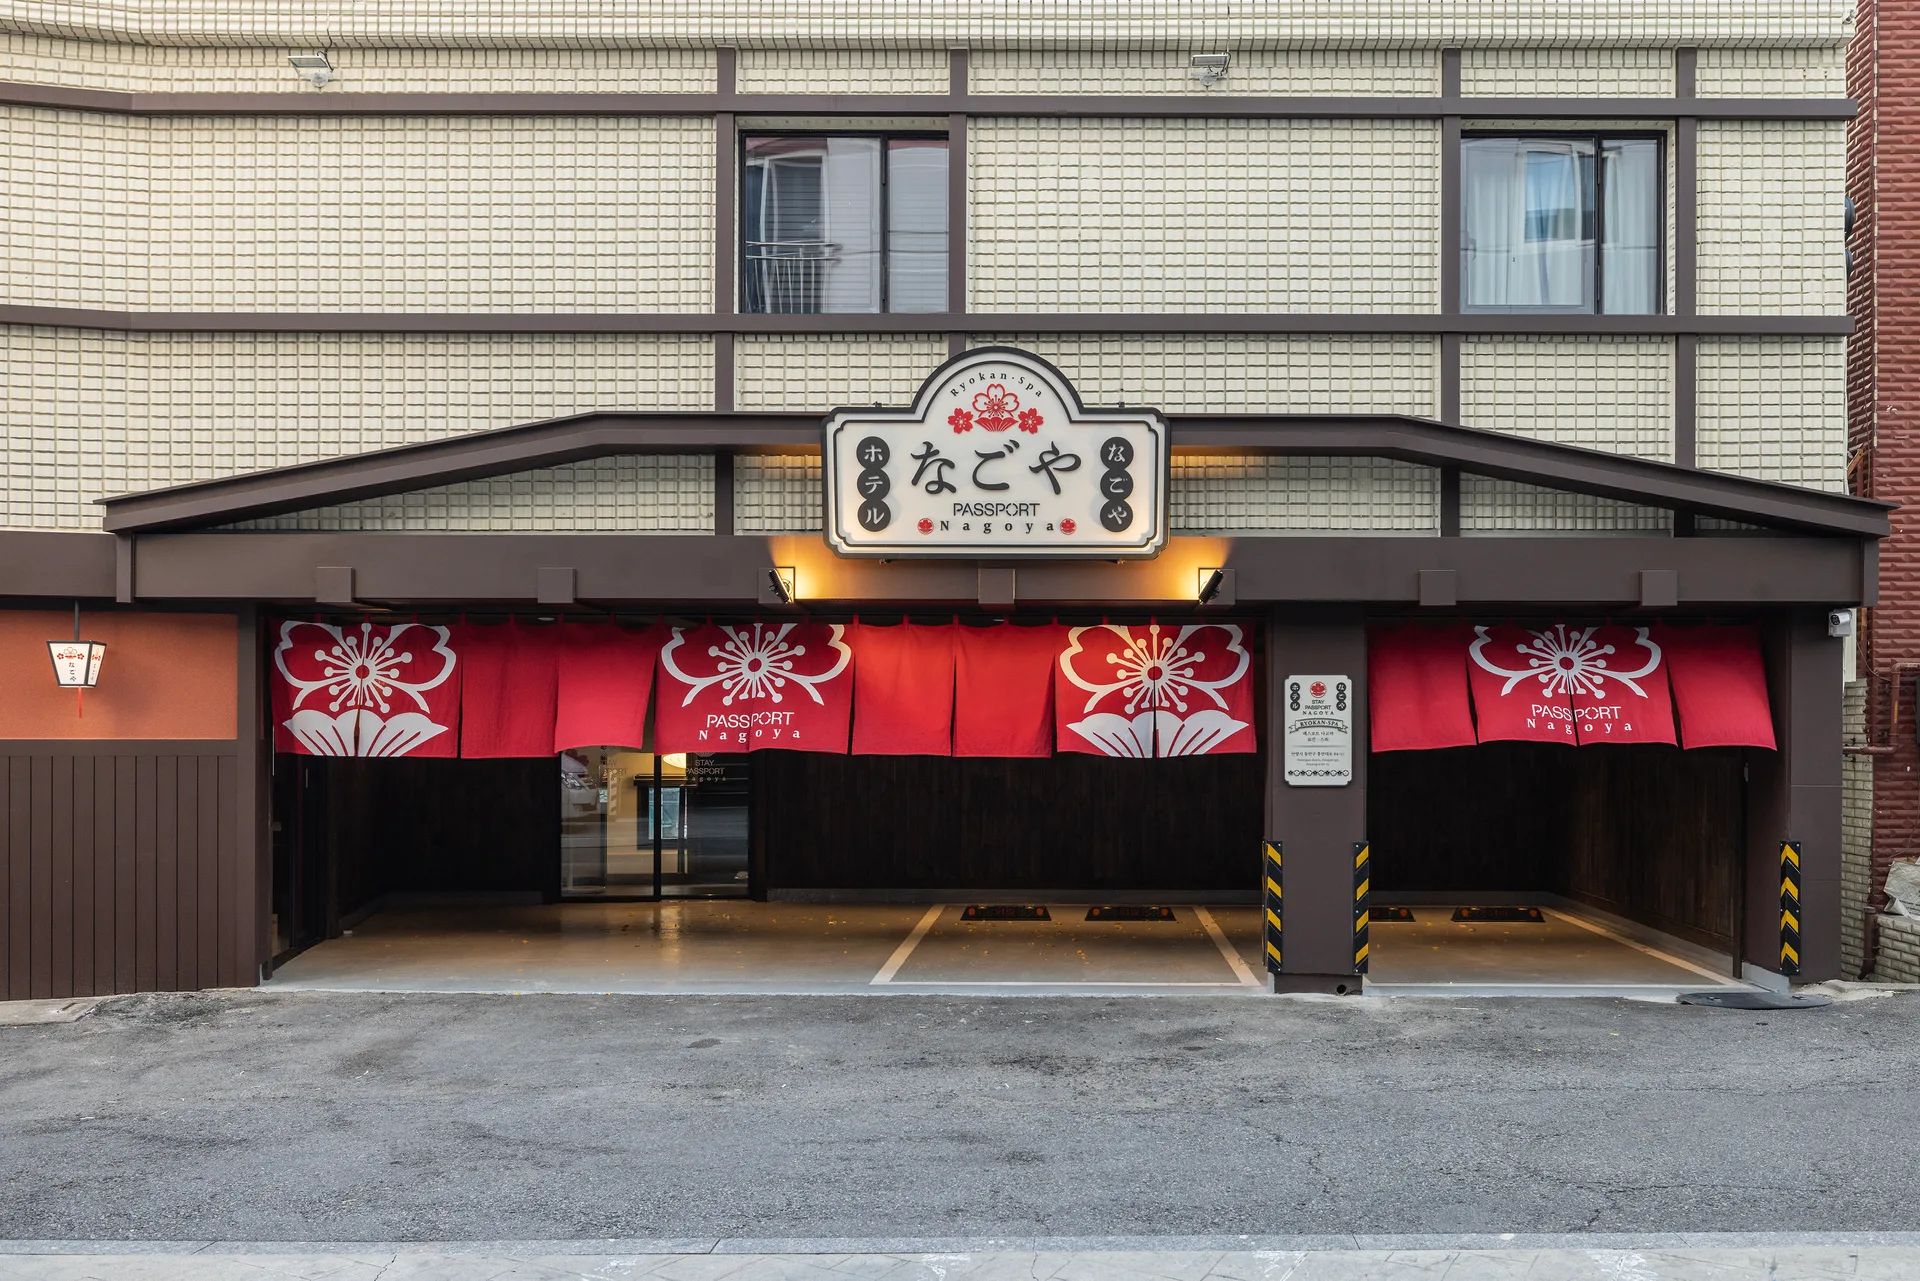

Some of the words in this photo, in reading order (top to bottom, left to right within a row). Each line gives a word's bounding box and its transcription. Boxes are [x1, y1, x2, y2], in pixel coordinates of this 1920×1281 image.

[910, 439, 1082, 495] なごや
[862, 442, 886, 526] ホテル
[1105, 441, 1129, 526] なごや
[952, 502, 1041, 517] PASSPORT
[939, 520, 1055, 536] Nagoya
[706, 711, 795, 729] PASSPORT
[1531, 704, 1622, 722] PASSPORT
[1526, 718, 1633, 735] Nagoya
[698, 728, 801, 744] Nagoya
[685, 767, 725, 775] PASSPORT
[694, 759, 715, 767] STAY
